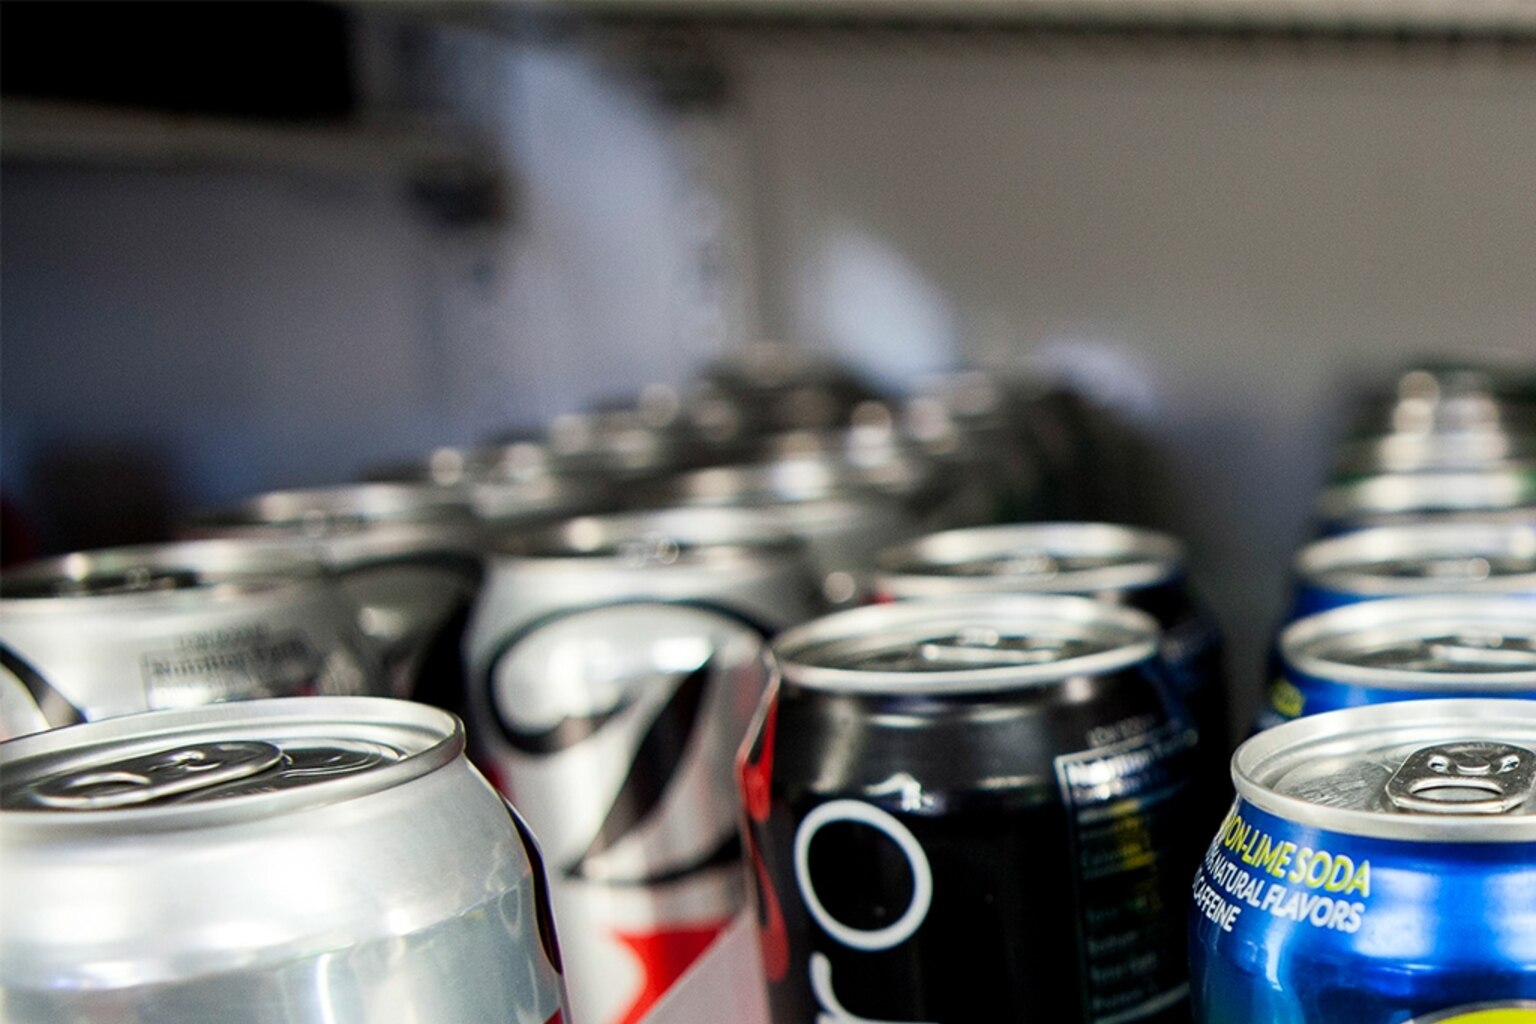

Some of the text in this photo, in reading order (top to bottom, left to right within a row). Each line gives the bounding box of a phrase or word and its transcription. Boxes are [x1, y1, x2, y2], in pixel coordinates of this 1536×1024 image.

[1209, 853, 1265, 908] NATURAL
[1260, 883, 1366, 934] FLAVORS
[1288, 846, 1372, 899] SODA
[1194, 876, 1242, 933] CAFFEINE
